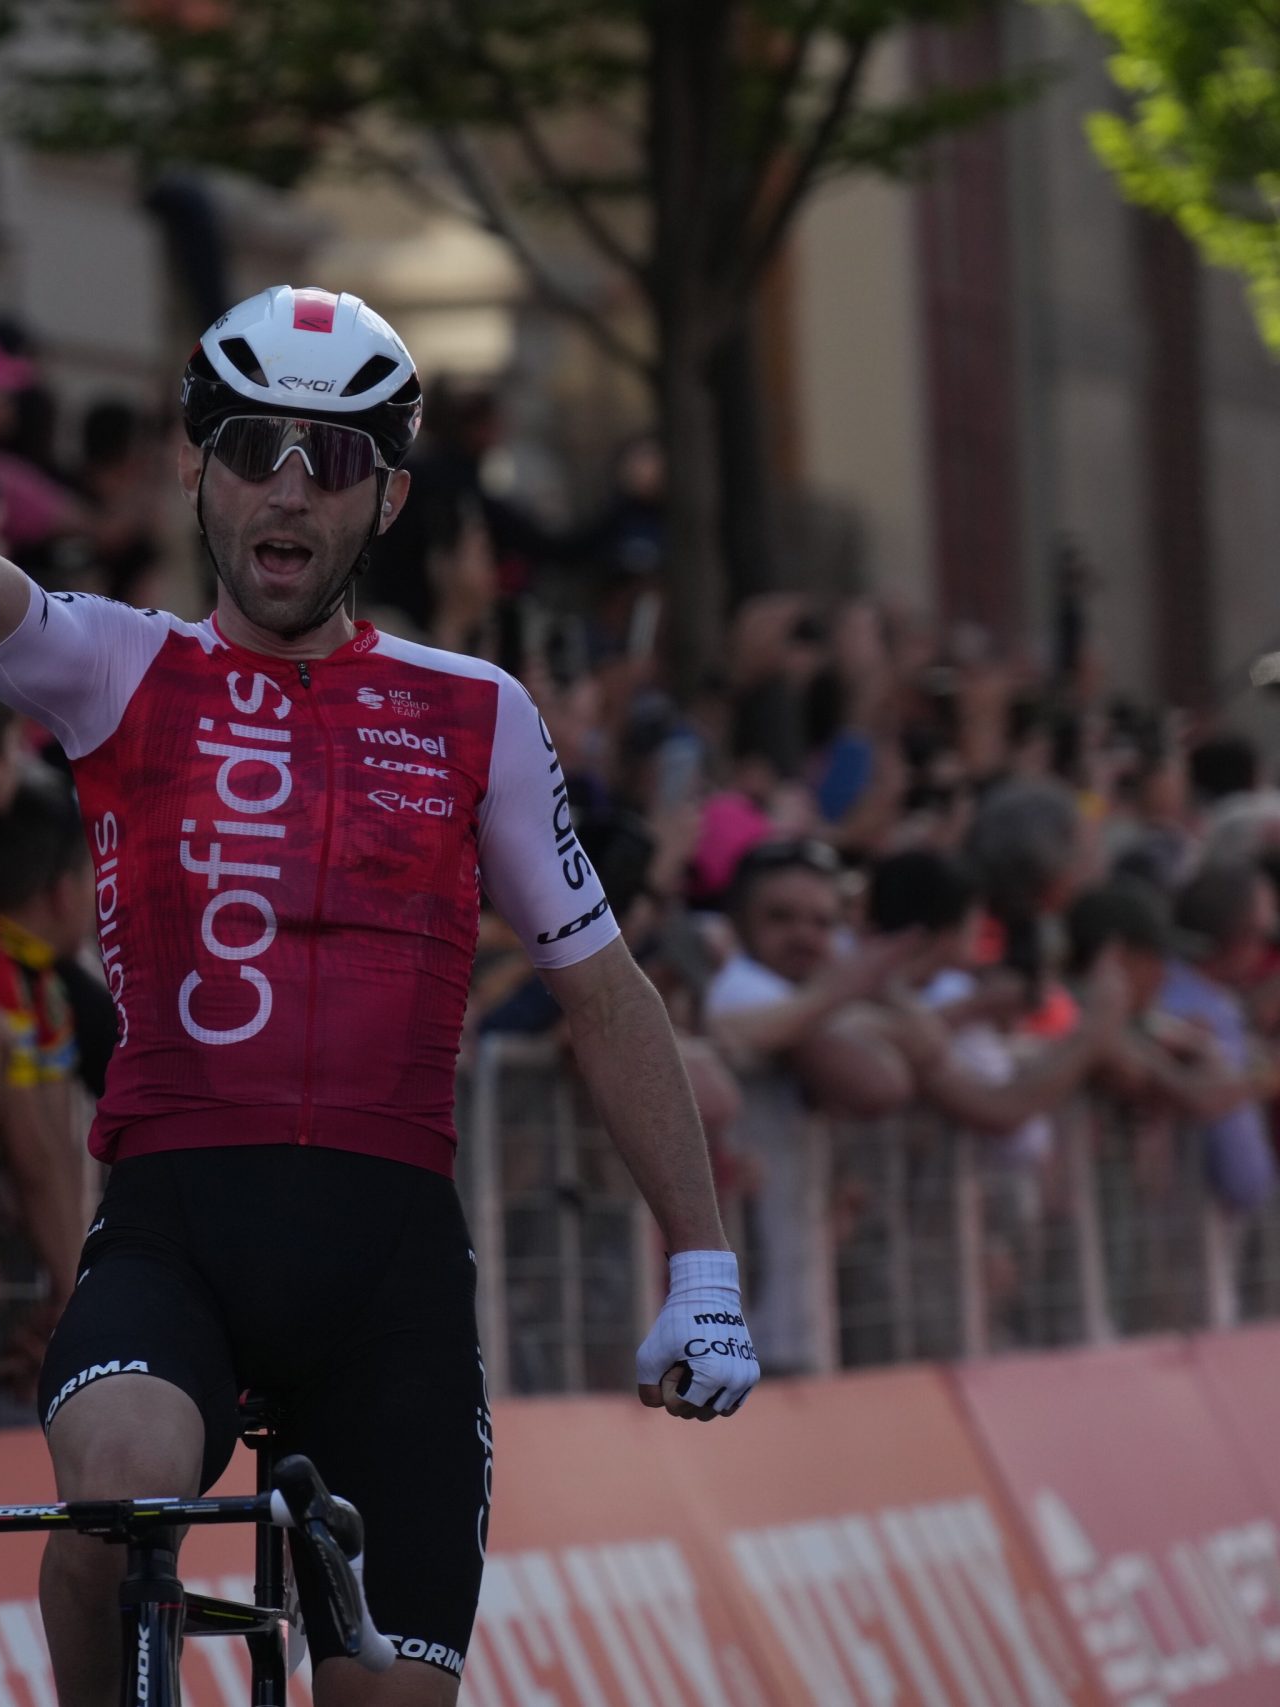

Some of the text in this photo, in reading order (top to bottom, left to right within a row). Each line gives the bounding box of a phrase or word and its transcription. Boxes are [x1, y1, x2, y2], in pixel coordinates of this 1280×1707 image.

[388, 690, 411, 700] UCI
[357, 728, 447, 758] mobel
[363, 756, 450, 780] LOOK
[178, 670, 292, 1046] Cofidis
[537, 897, 609, 945] LOO
[45, 1360, 149, 1434] ORIMA
